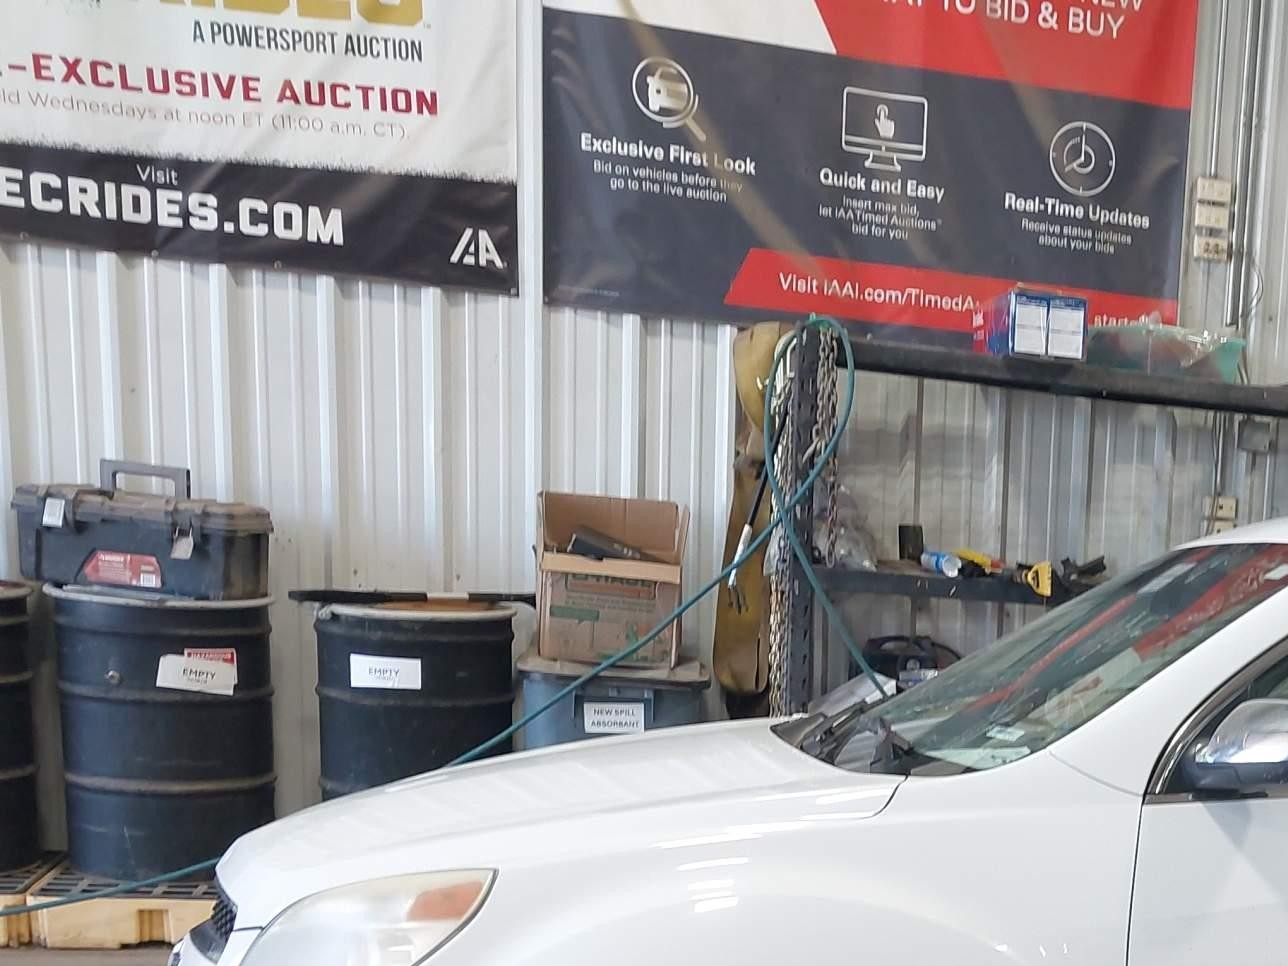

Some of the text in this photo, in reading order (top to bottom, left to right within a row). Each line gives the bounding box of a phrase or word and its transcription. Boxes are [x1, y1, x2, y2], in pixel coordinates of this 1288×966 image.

[986, 0, 1030, 24] BID
[1038, 1, 1058, 30] &
[1068, 6, 1125, 39] BUY
[193, 19, 423, 62] A POWERSPORT AUCTION
[276, 79, 439, 117] AUCTION
[27, 90, 157, 121] Wednesdays
[164, 109, 181, 121] at
[188, 111, 236, 127] noon
[242, 112, 263, 127] ET
[271, 114, 324, 132] (11:00
[330, 121, 367, 136] a.m.
[373, 122, 410, 140] CT).
[580, 132, 756, 176] Exclusive First Look
[136, 163, 179, 186] Visit
[593, 159, 743, 193] Bid on vehicles before they
[820, 167, 945, 204] Quick and Easy
[610, 177, 727, 203] go to the live auction
[842, 194, 872, 210] Insert
[1004, 192, 1150, 229] Real-Time Updates
[852, 223, 908, 240] bid for you
[1021, 218, 1132, 245] Receive status updates
[1038, 234, 1115, 255] about your bids
[779, 271, 818, 295] Visit
[182, 668, 216, 680] EMPTY
[368, 667, 400, 677] EMPTY
[614, 709, 634, 717] SPILL
